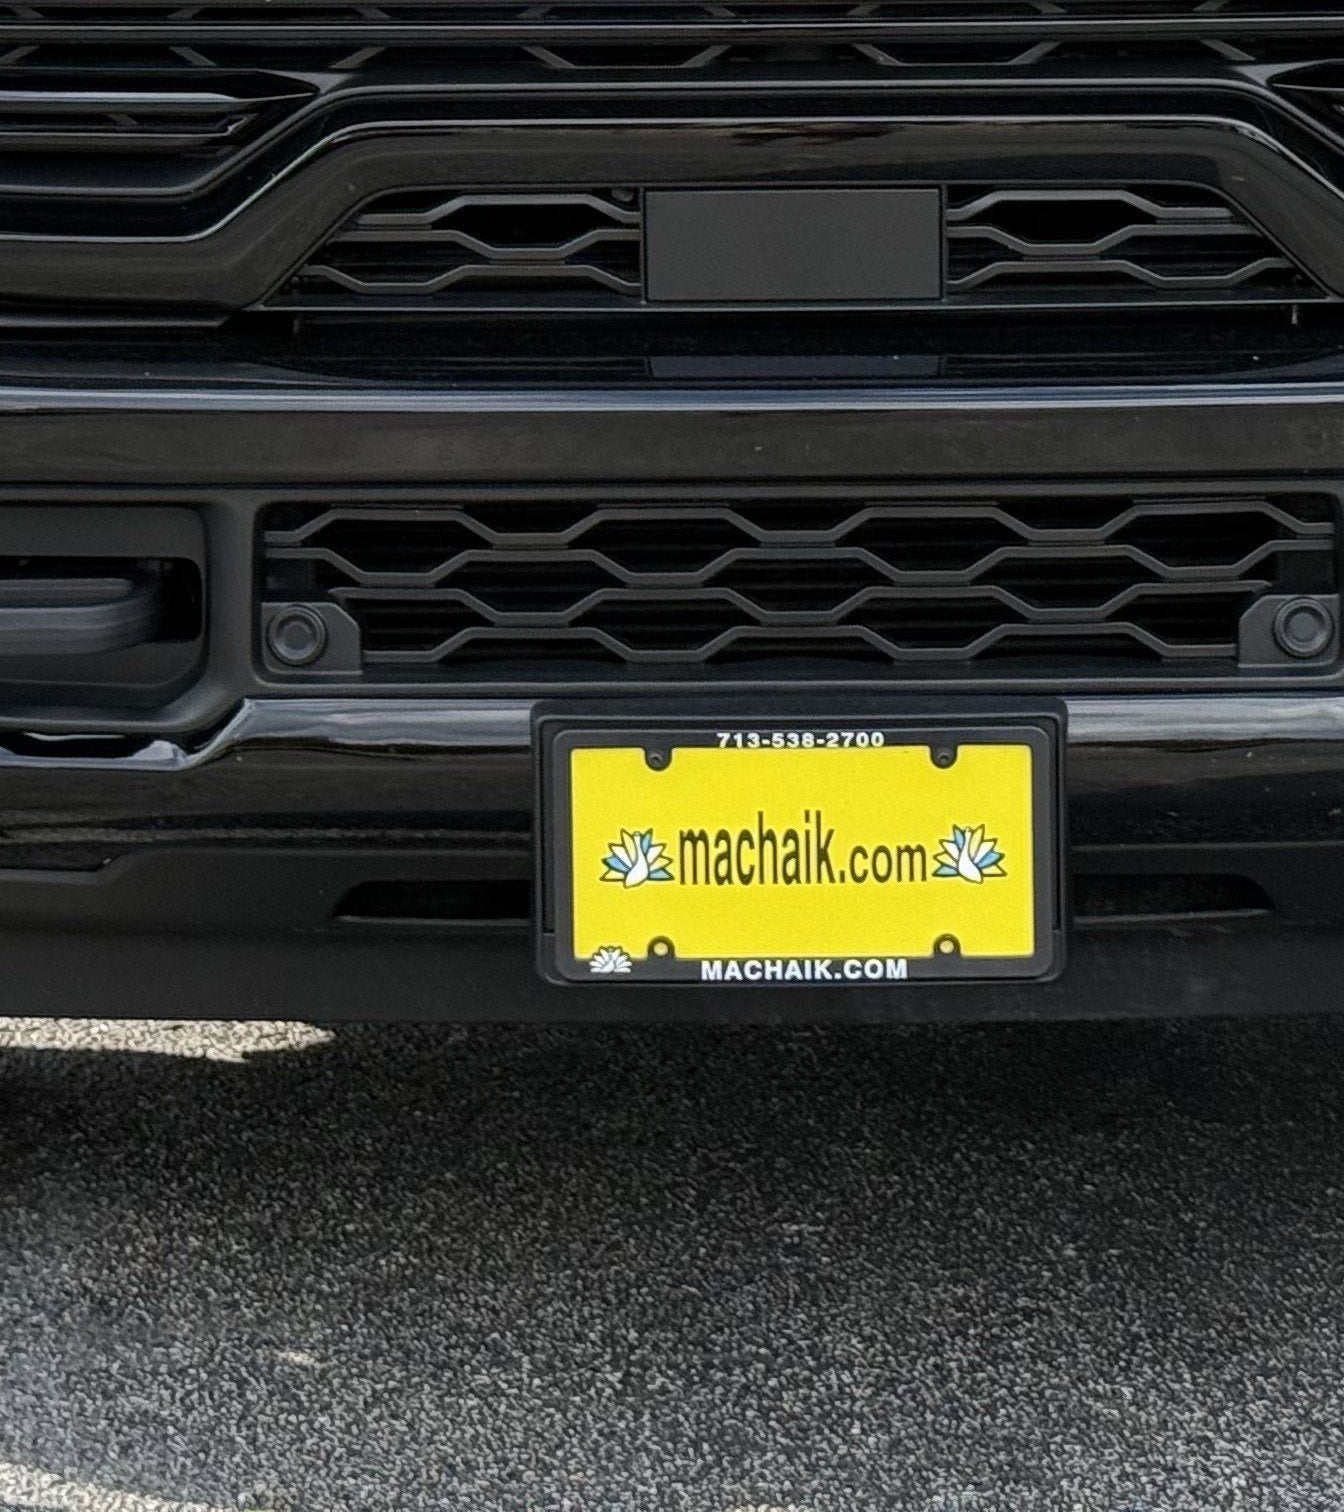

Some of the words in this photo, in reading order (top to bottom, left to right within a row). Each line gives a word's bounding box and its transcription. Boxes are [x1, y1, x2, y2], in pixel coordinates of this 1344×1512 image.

[716, 731, 885, 749] 713-538-2700
[677, 809, 929, 886] machaik.com
[700, 958, 909, 982] MACHAIK.COM
